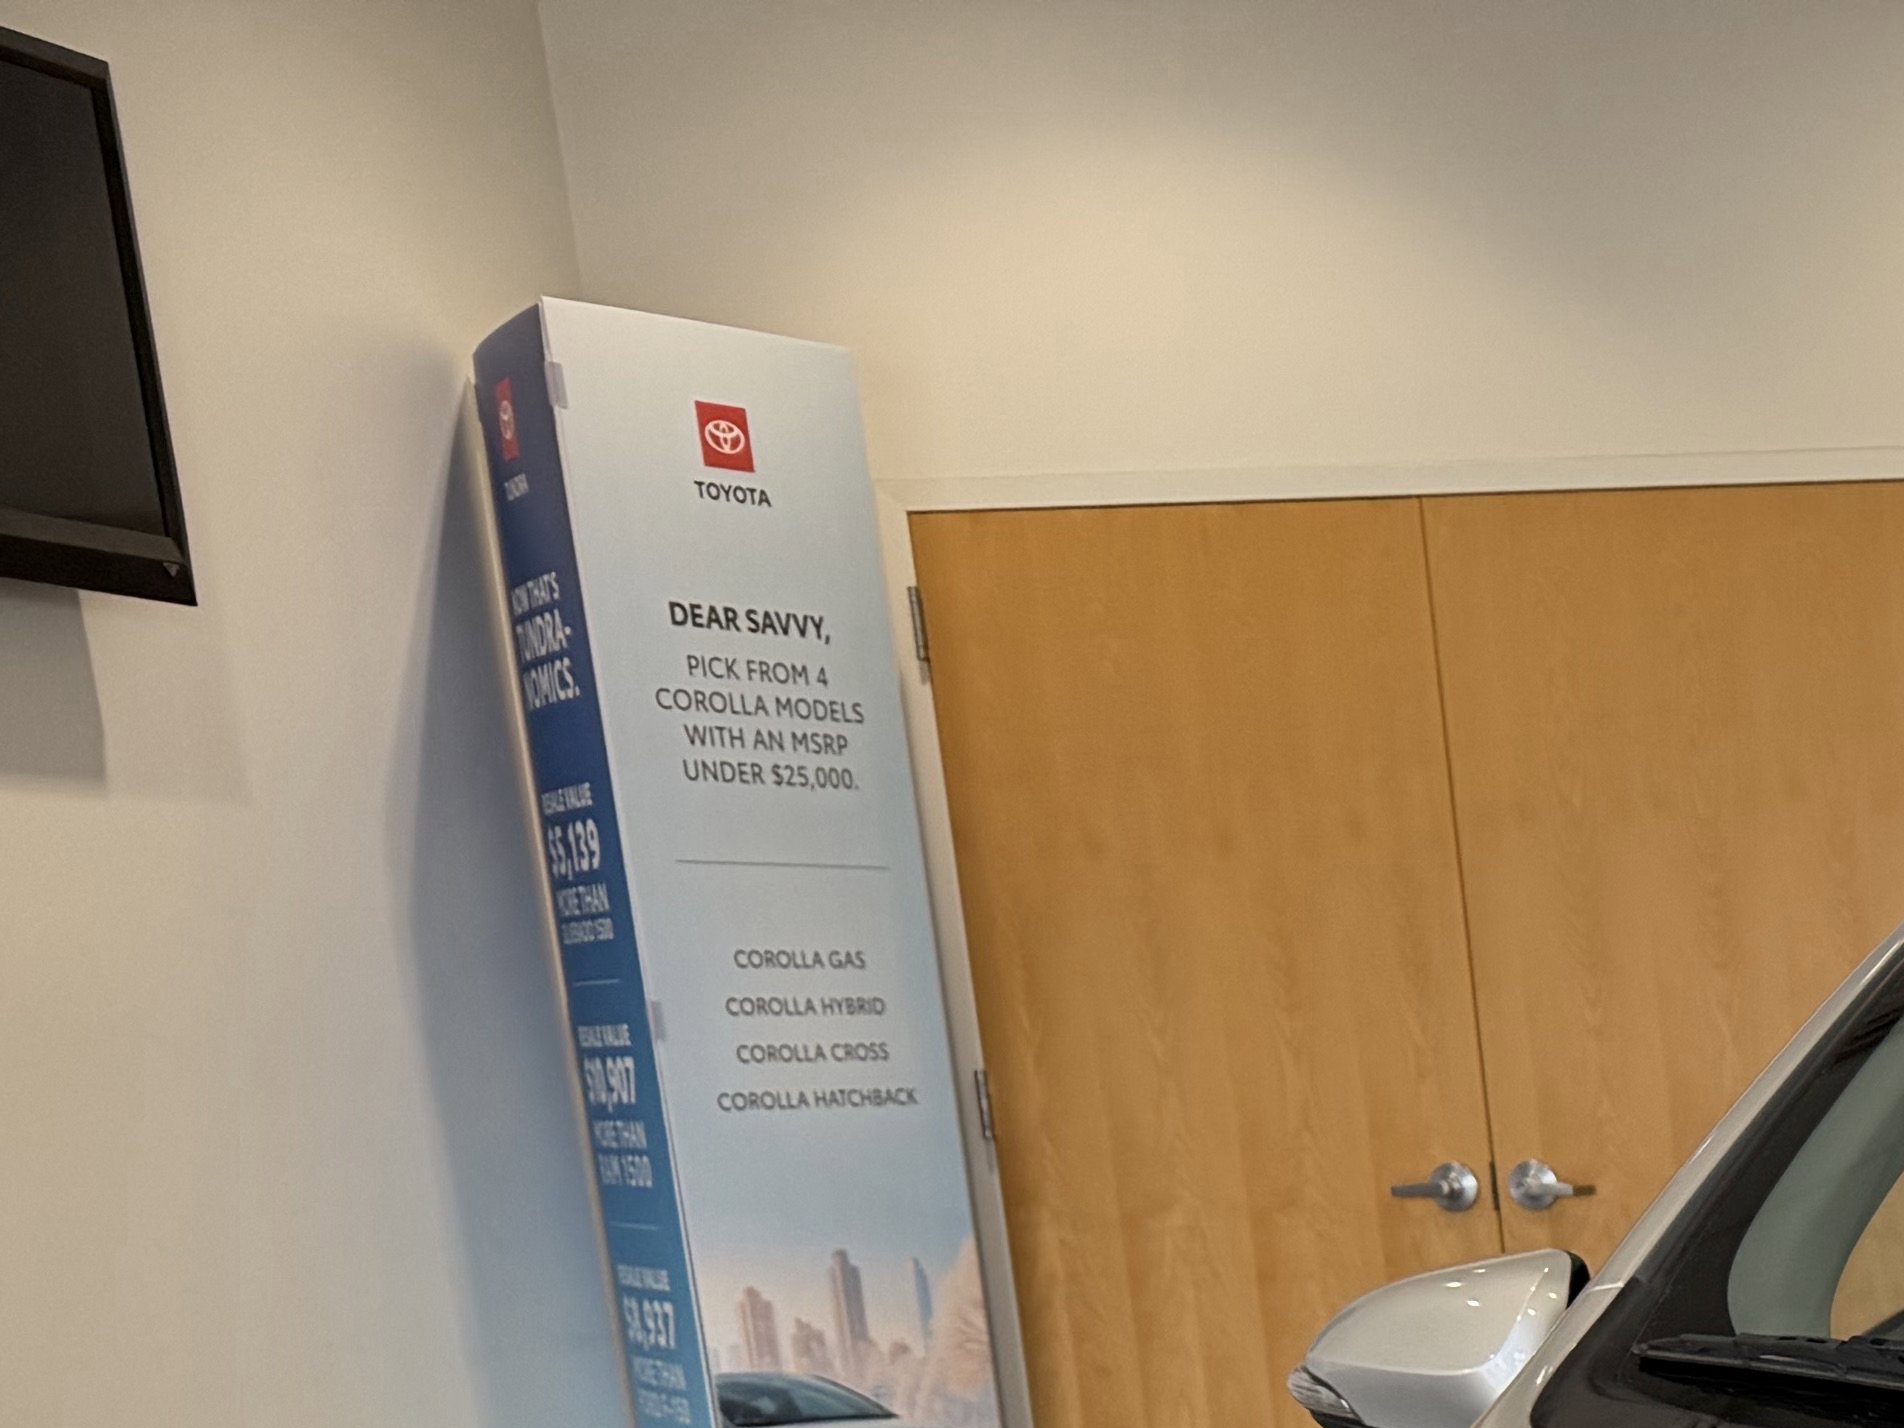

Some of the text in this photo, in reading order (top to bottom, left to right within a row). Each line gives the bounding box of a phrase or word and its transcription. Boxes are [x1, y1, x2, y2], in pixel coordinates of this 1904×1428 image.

[693, 480, 772, 508] TOYOTA
[669, 601, 831, 645] DEAR SAVVY,
[687, 654, 828, 688] PICK FROM 4
[655, 687, 865, 724] COROLLA MODELS
[683, 723, 849, 756] WITH AN MSRP
[682, 758, 860, 792] UNDER $25,000.
[548, 818, 601, 880] $5,139
[733, 949, 866, 969] COROLLA GAS
[725, 996, 886, 1016] COROLLA HYBRID
[736, 1042, 889, 1064] COROLLA CROSS
[717, 1087, 919, 1112] COROLLA HATCHBACK
